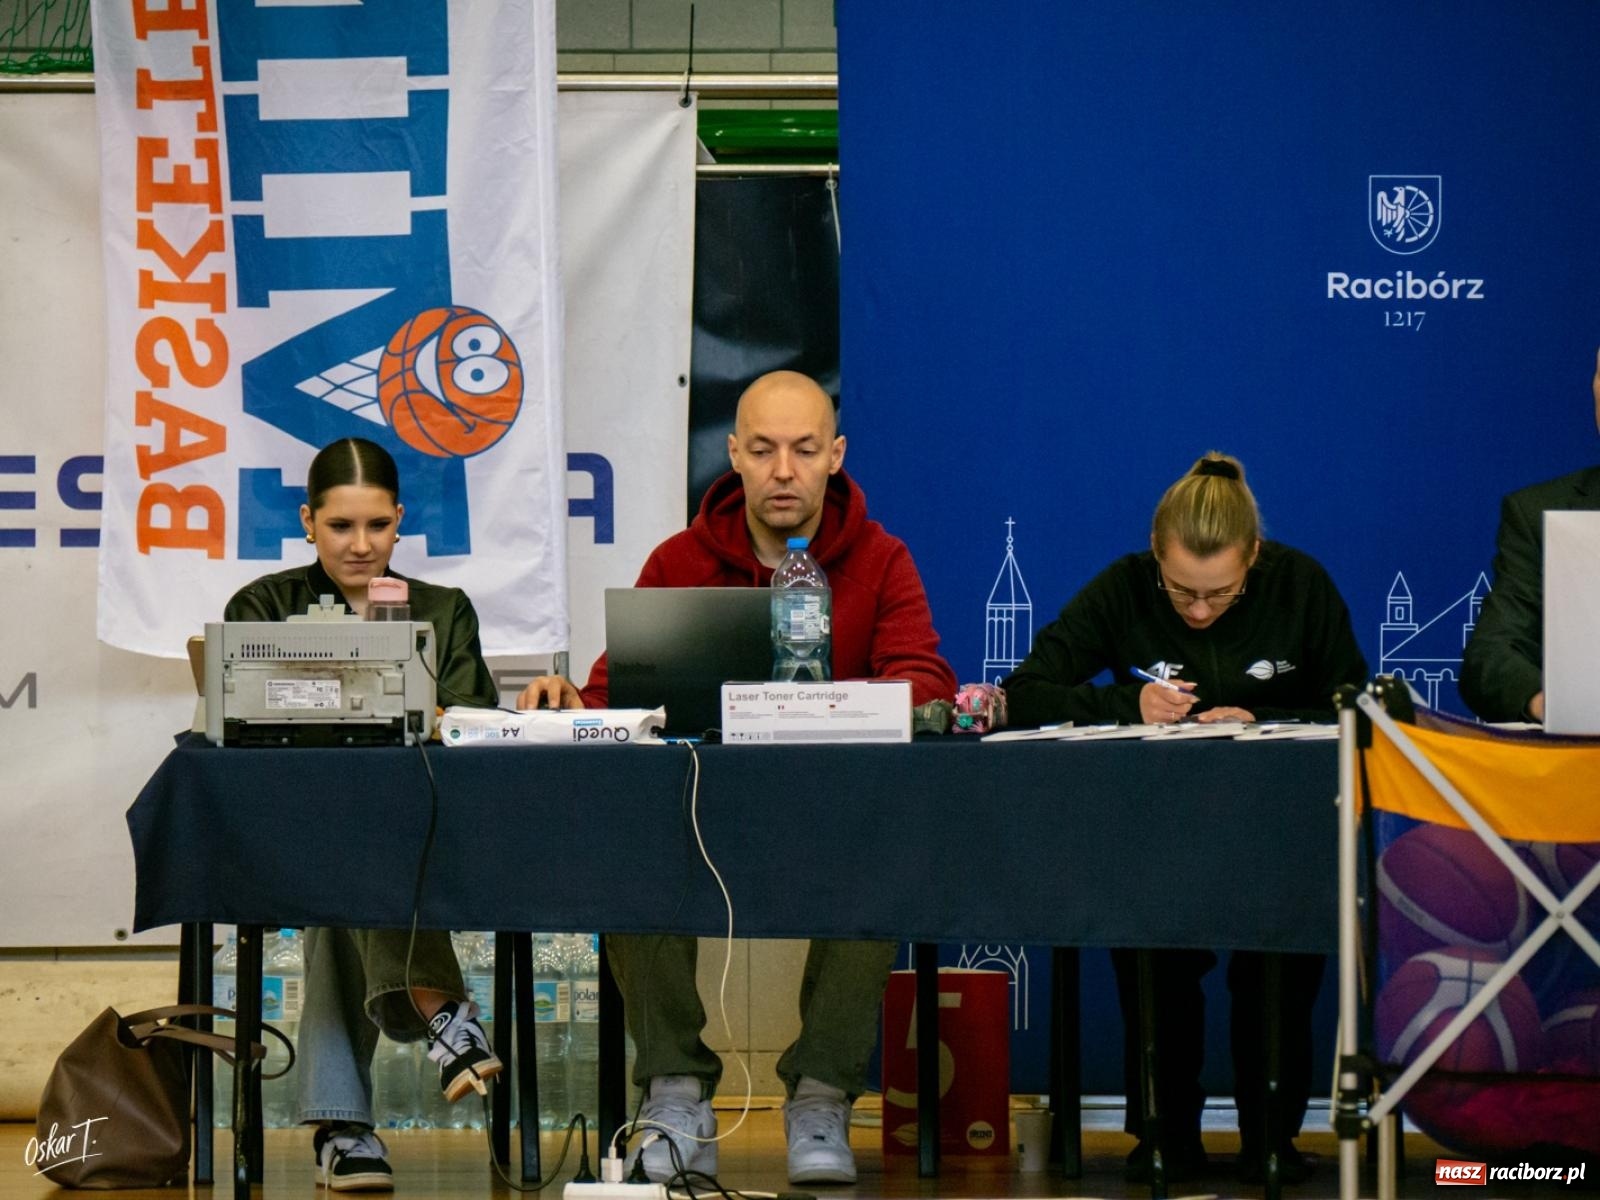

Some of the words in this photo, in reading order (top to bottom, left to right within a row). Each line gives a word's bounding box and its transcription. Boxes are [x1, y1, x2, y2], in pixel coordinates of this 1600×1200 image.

[1327, 270, 1485, 300] Racibórz
[1384, 311, 1426, 332] 1217
[728, 692, 759, 702] Laser
[763, 691, 794, 701] Toner
[797, 691, 848, 702] Cartridge
[502, 728, 520, 738] A4
[573, 727, 630, 742] Quedi
